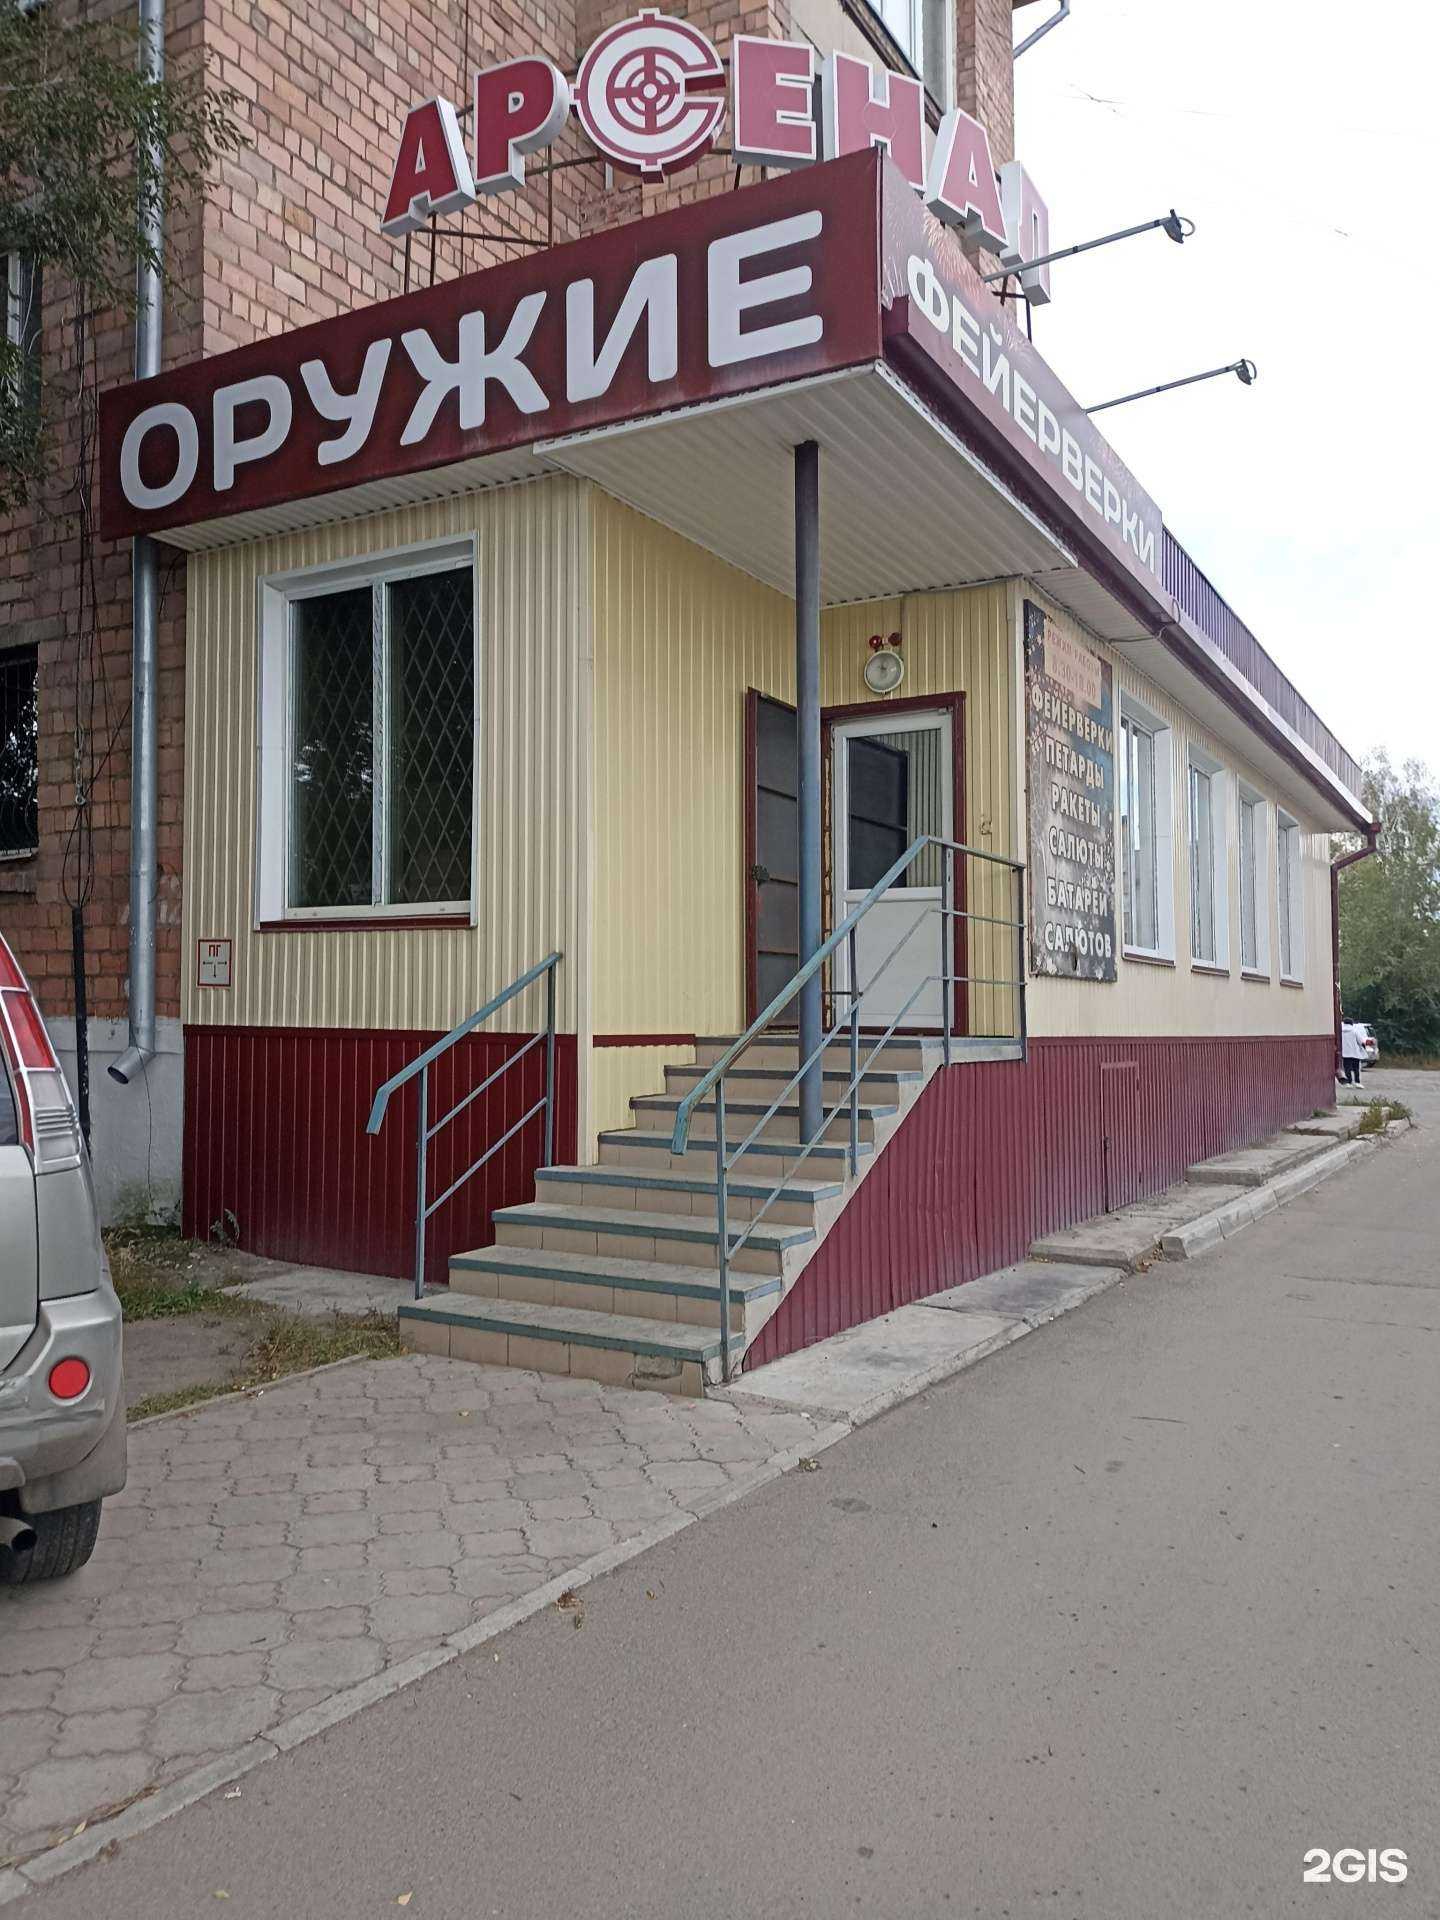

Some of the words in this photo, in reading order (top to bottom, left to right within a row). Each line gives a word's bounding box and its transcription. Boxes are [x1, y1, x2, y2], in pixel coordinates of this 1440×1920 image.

[378, 7, 1051, 304] АРСЕНАЛ
[119, 208, 826, 511] ОРУЖИЕ
[907, 254, 1157, 575] ФЕЙЕРВЕРКИ
[1045, 736, 1104, 789] ПЕТАРДЫ
[1051, 783, 1101, 828] РАКЕТЫ
[1049, 827, 1104, 868] САЛЮТЫ
[208, 944, 221, 957] ПГ
[1045, 922, 1112, 958] САЛЮТОВ
